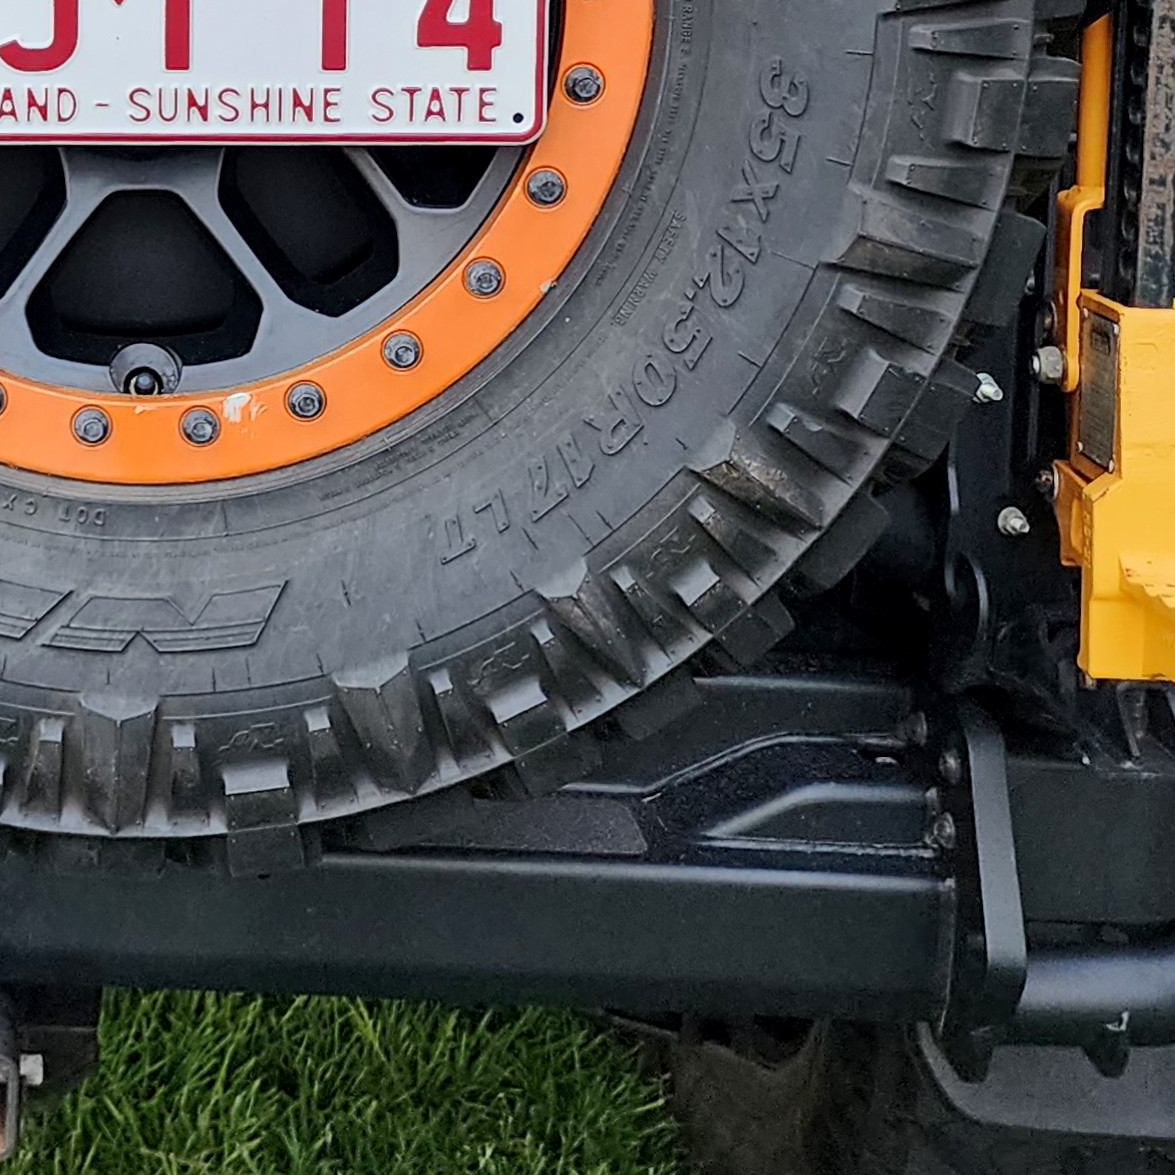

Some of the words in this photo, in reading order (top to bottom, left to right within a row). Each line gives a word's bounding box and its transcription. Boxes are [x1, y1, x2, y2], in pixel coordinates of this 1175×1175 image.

[128, 86, 342, 124] SUNSHINE
[370, 86, 498, 123] STATE
[58, 505, 107, 527] DOT
